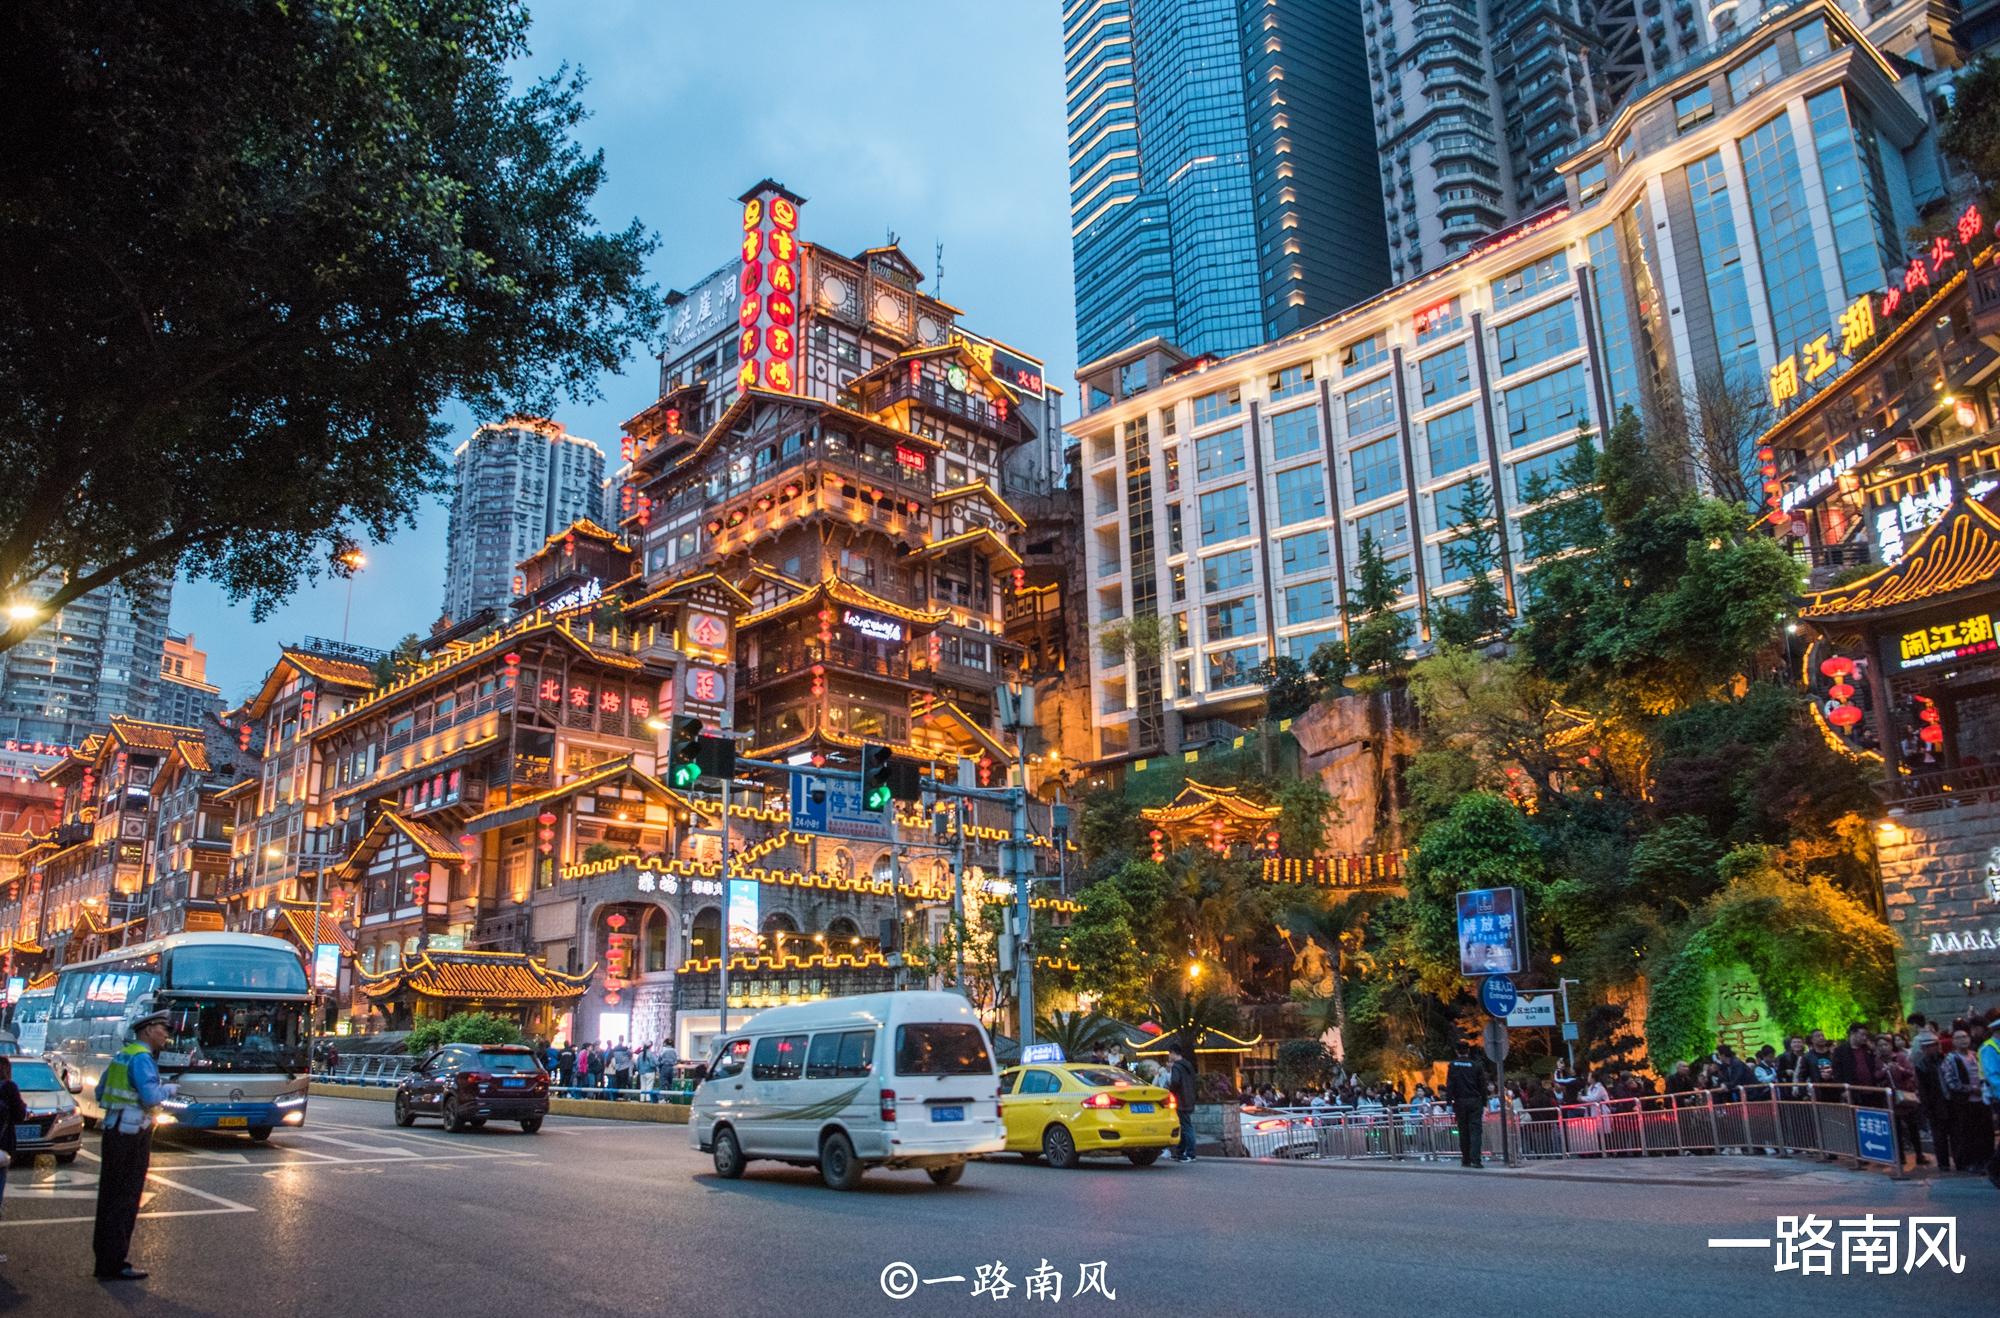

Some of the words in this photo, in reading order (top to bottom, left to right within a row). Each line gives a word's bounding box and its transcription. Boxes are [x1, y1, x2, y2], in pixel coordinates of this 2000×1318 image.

[1882, 205, 1982, 316] 山城火锅
[675, 274, 737, 337] 洪崖洞
[1769, 294, 1875, 408] 闹江湖
[1901, 614, 1993, 659] 闹江湖
[540, 679, 649, 718] 北京烤鸭
[1463, 914, 1512, 934] 解放碑
[1929, 927, 2000, 953] AAAA
